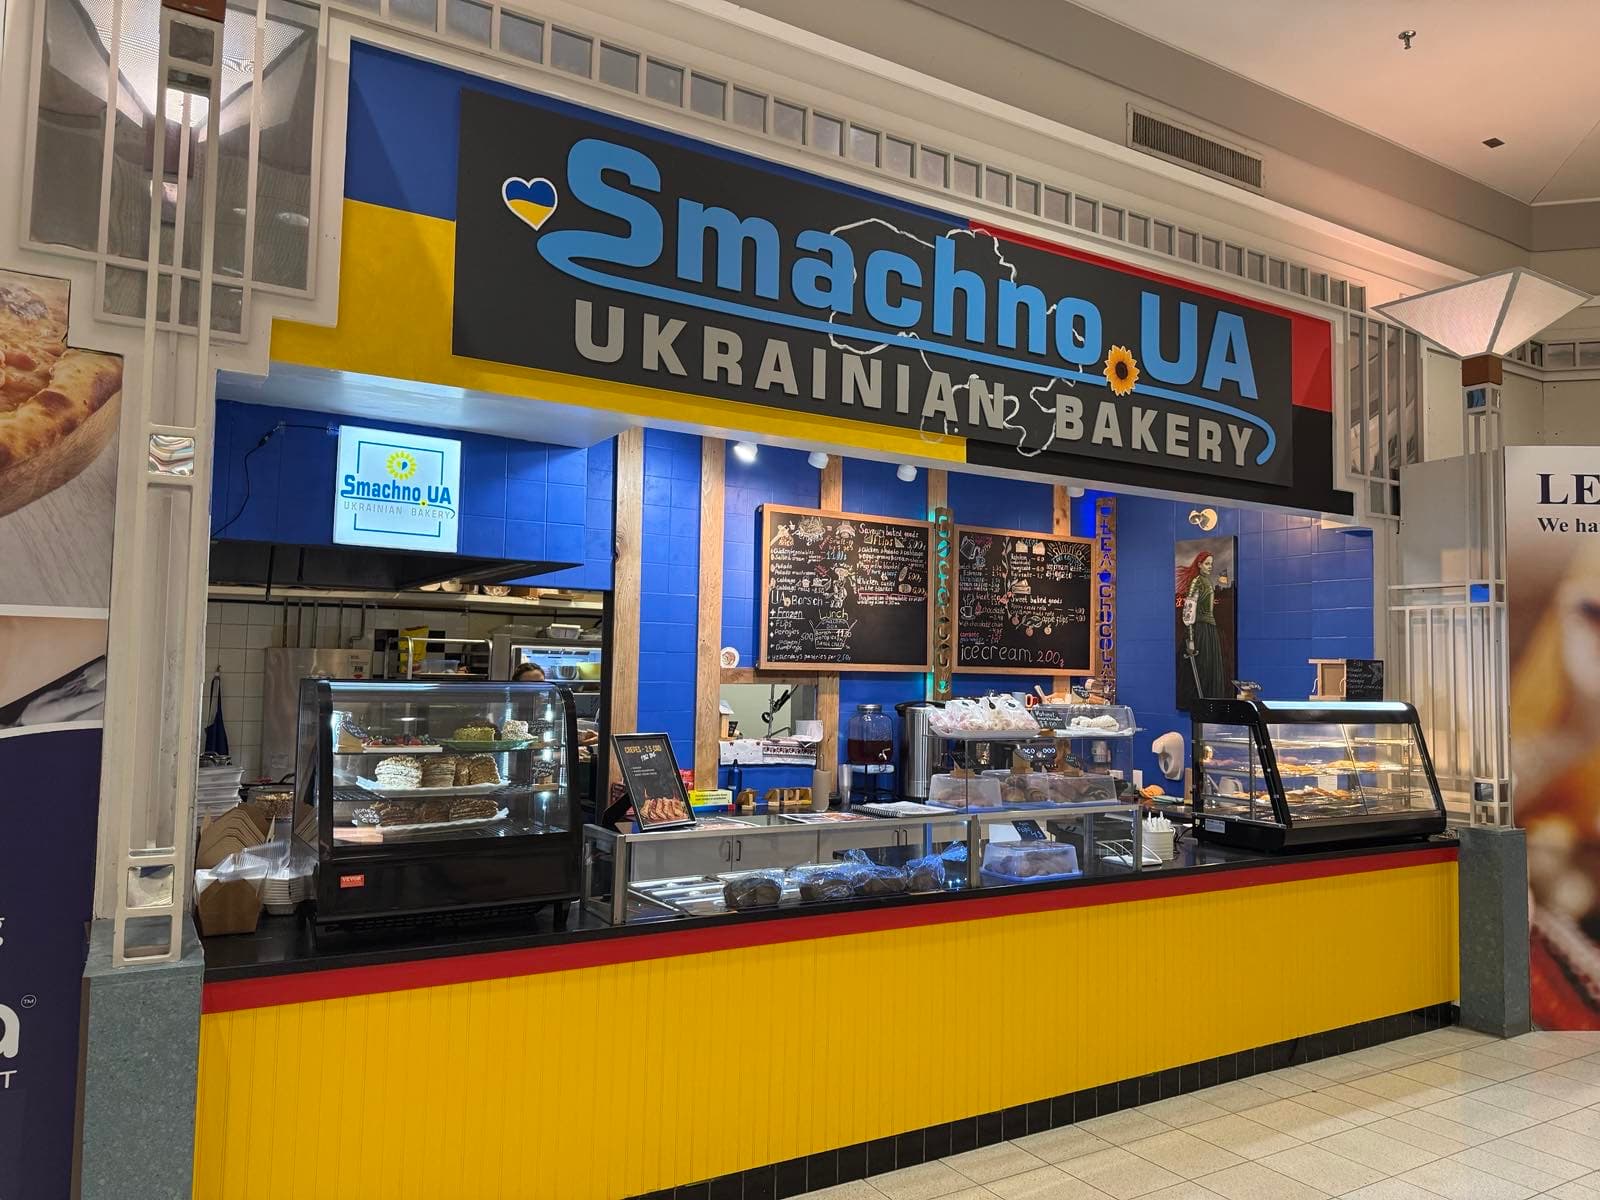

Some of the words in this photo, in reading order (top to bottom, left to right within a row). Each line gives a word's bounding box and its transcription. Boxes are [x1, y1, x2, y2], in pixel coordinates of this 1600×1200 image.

[574, 298, 1005, 430] UKRAINIAN
[1055, 394, 1253, 466] BAKERY
[343, 501, 403, 514] UKRAINIAN
[411, 508, 451, 519] BAKERY
[1537, 518, 1568, 532] We
[1575, 519, 1600, 532] ha
[792, 595, 823, 606] Borsch
[777, 606, 803, 618] Frozen
[819, 608, 849, 620] Lunch
